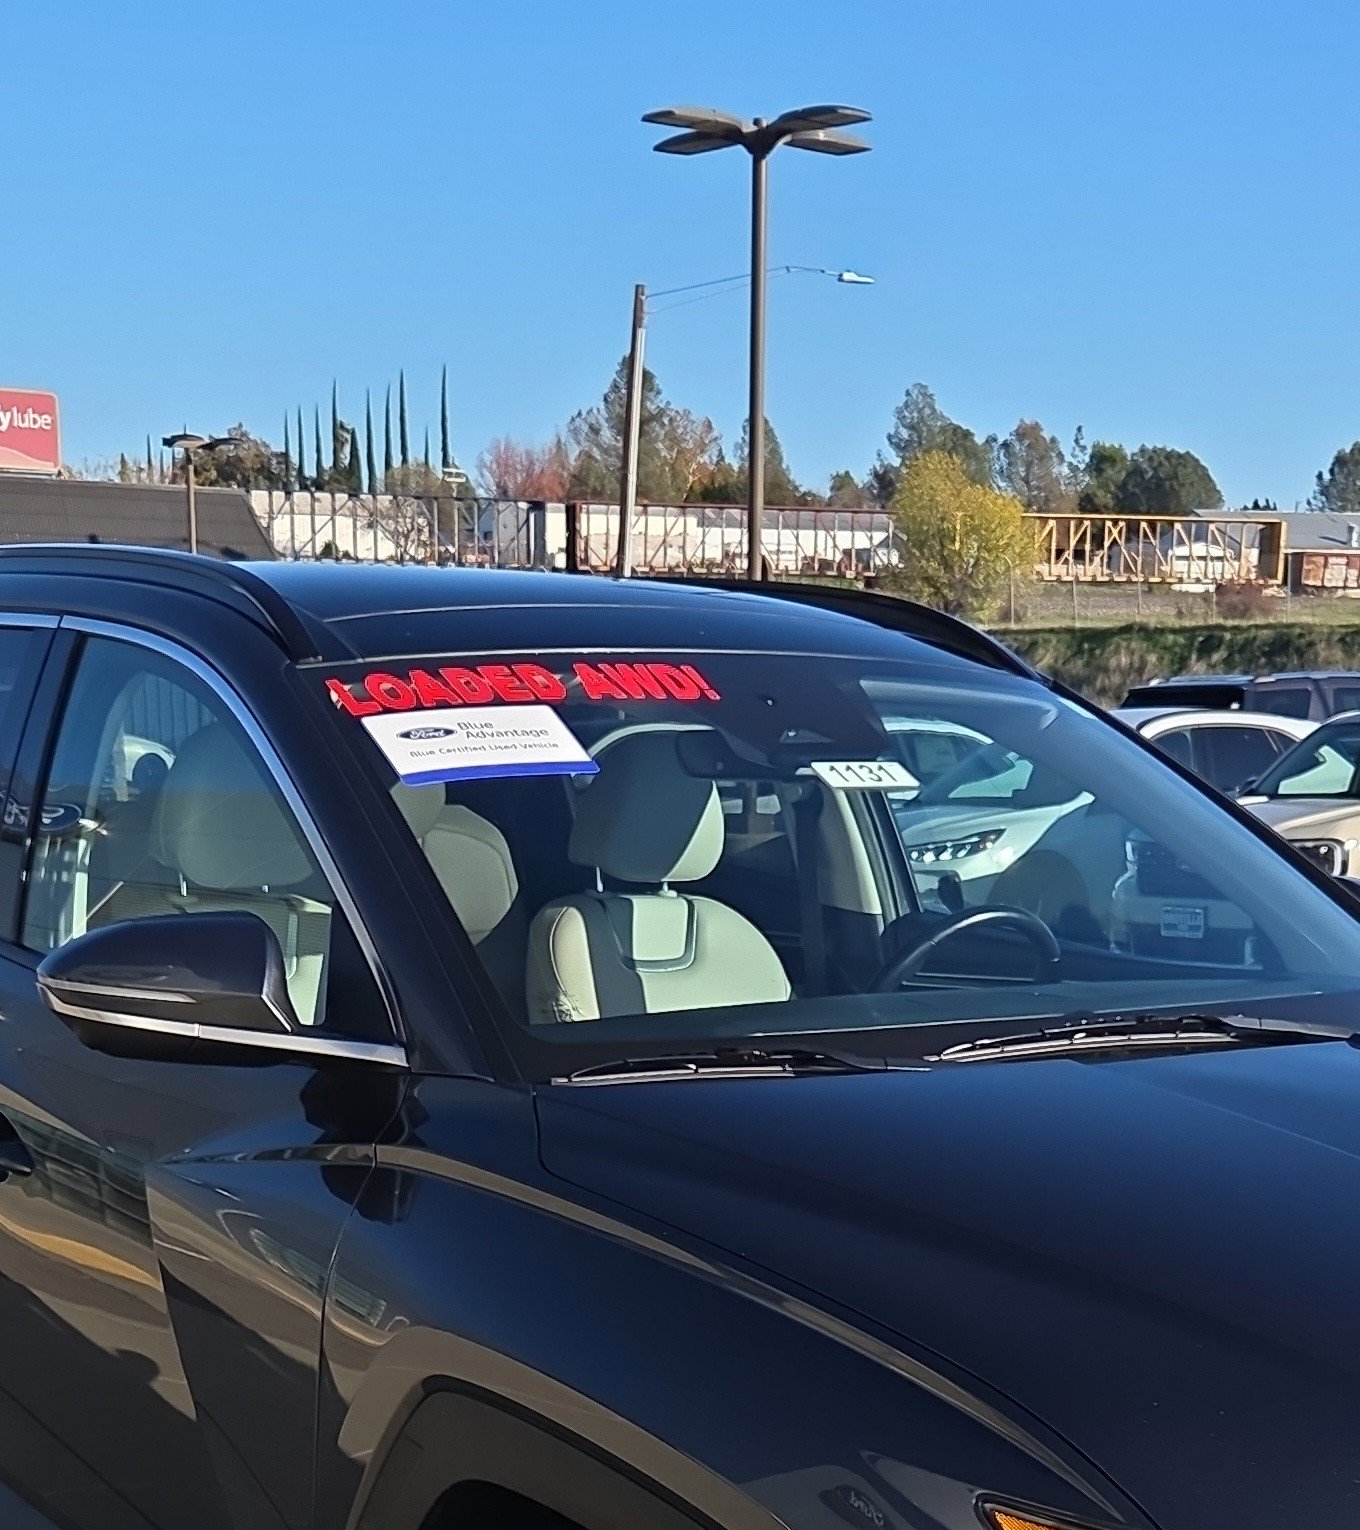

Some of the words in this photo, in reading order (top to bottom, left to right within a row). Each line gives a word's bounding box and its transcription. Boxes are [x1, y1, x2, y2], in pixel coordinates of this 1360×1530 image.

[325, 663, 568, 716] LOADED
[573, 663, 721, 700] AWD!
[456, 721, 495, 731] Blue
[465, 728, 550, 739] Advantage
[409, 749, 436, 758] Blue
[439, 745, 487, 756] Certified
[489, 743, 518, 751] Used
[519, 742, 559, 750] Vehicle
[828, 764, 898, 783] 1131
